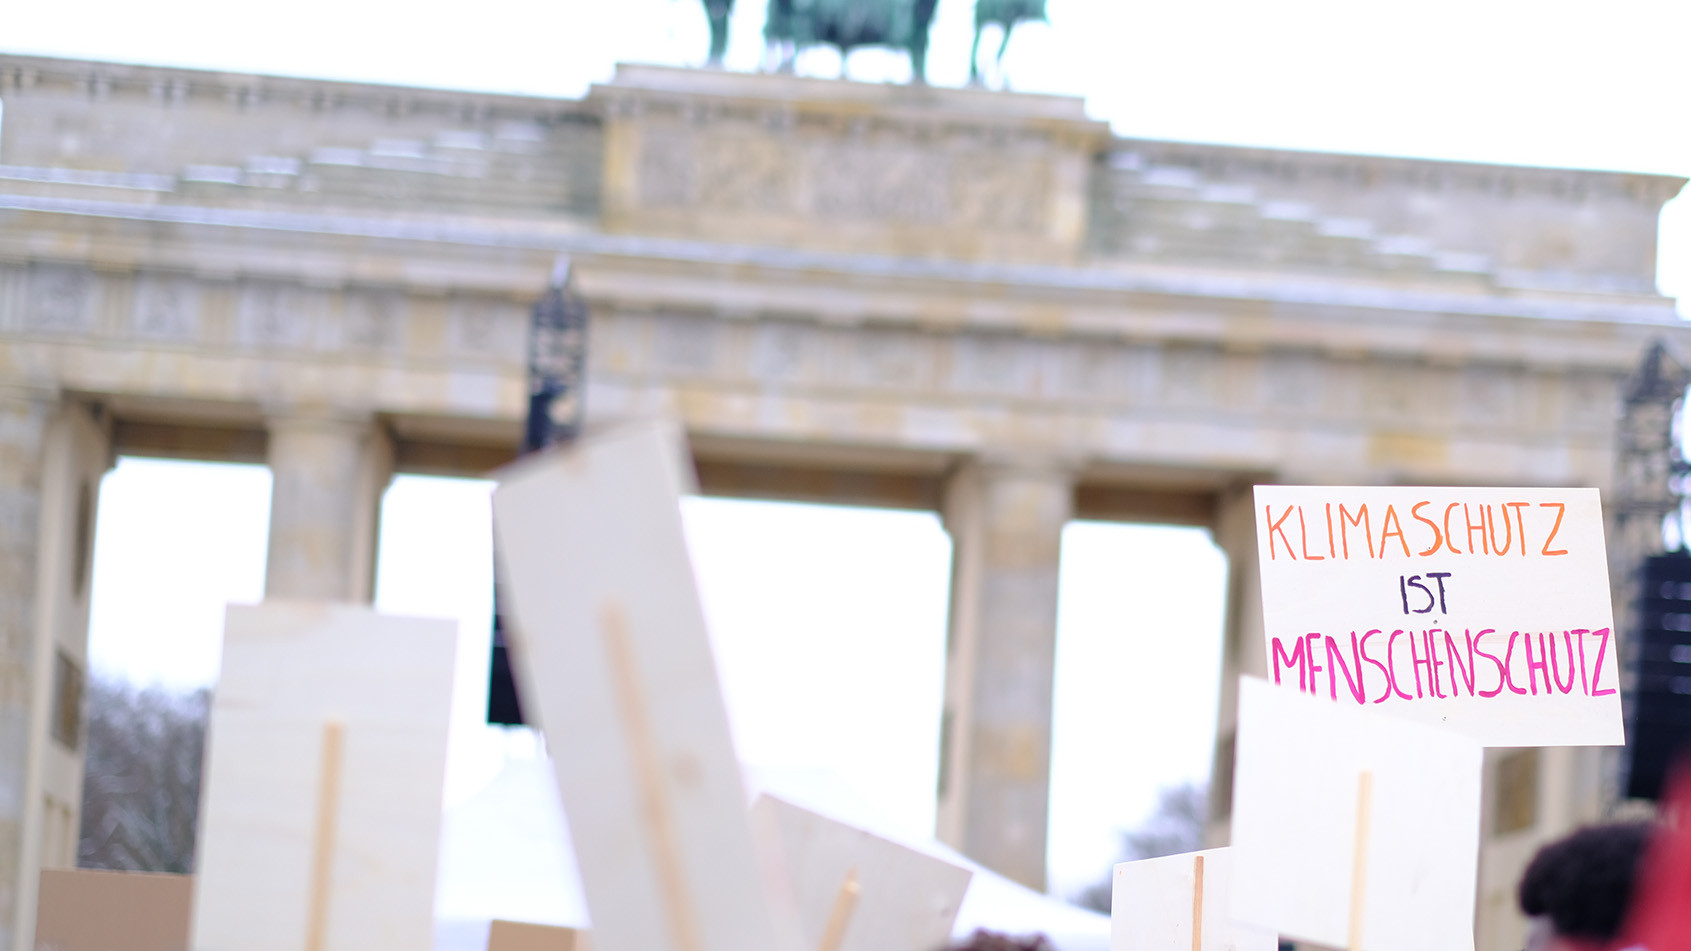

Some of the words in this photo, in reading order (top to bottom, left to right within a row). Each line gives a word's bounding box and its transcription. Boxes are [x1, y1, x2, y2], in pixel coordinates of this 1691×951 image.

[1266, 501, 1568, 560] KLIMASCHUTZ
[1400, 572, 1451, 615] IST
[1272, 627, 1617, 705] MENSCHENSCHUTZ
